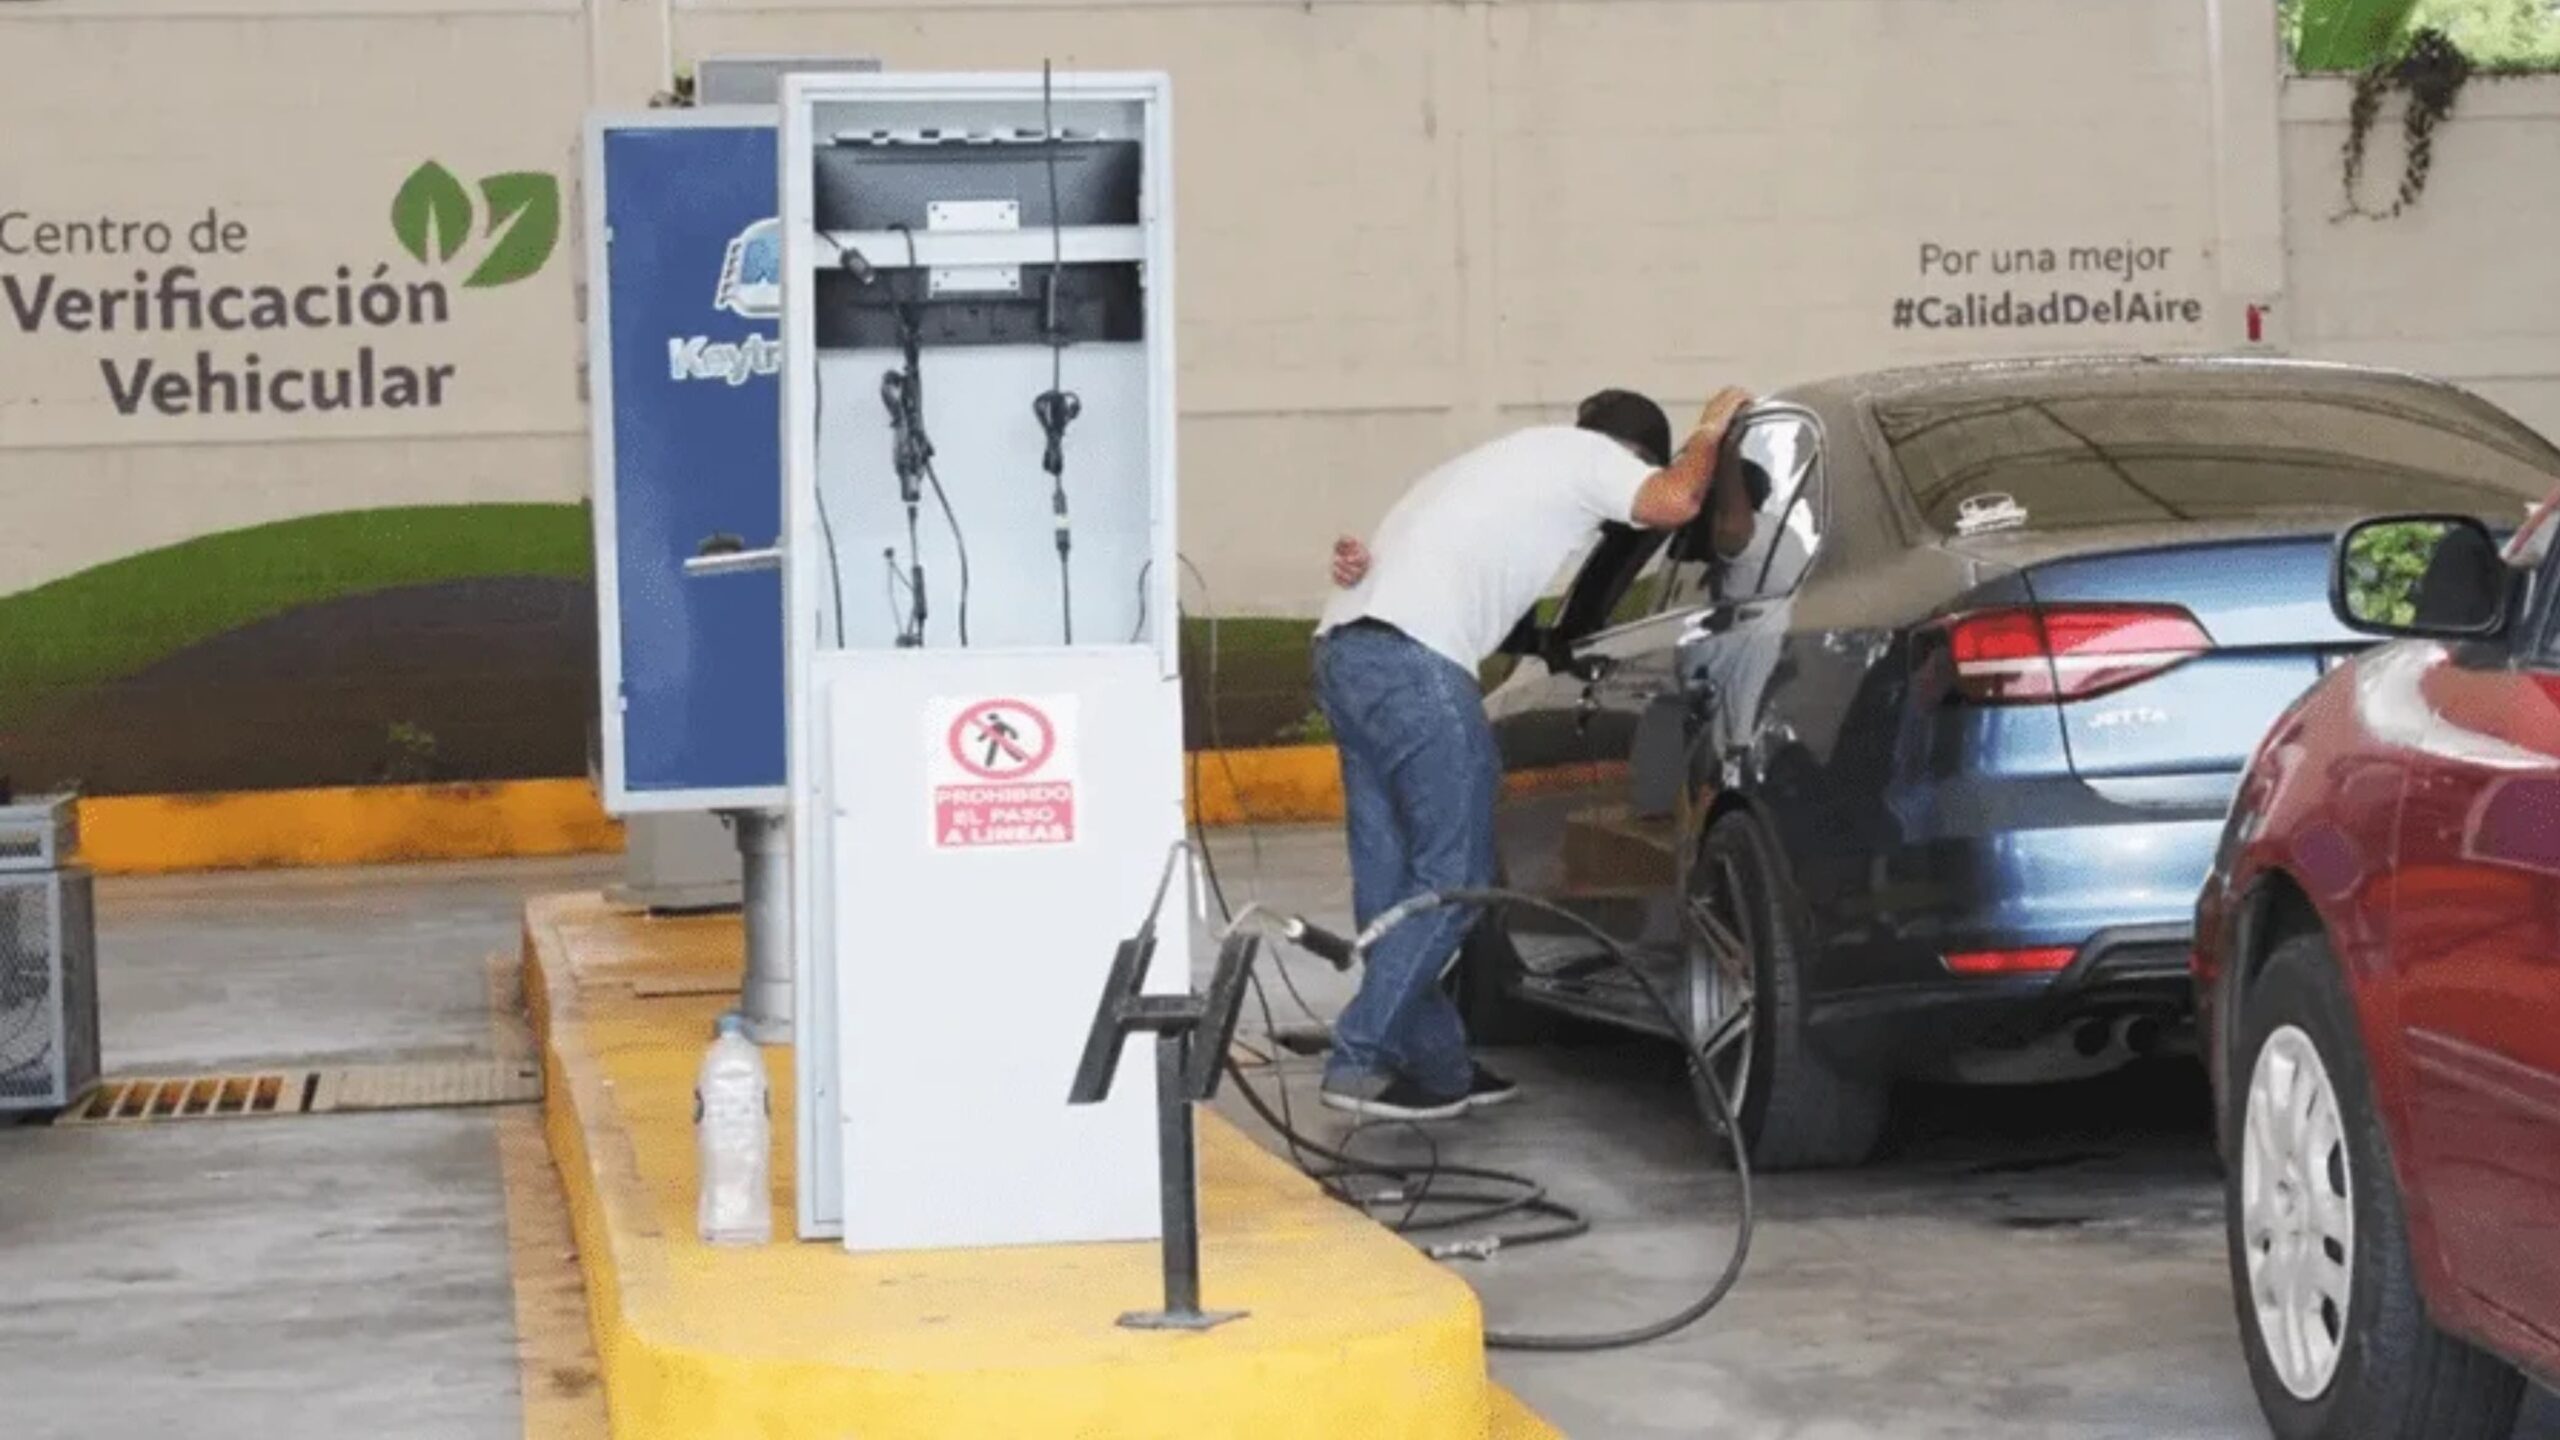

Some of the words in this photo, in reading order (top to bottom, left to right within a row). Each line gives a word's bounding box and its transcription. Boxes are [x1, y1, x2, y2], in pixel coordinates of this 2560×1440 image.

[0, 212, 172, 255] Centro
[188, 208, 248, 253] de
[1919, 243, 1980, 275] Por
[1992, 247, 2056, 273] una
[2068, 239, 2172, 282] mejor
[2, 263, 449, 332] Verificación
[1892, 289, 2202, 328] #CalidadDelAire
[100, 346, 455, 416] Vehicular
[935, 785, 1069, 805] PROHIBIDO
[989, 805, 1056, 824] PASO
